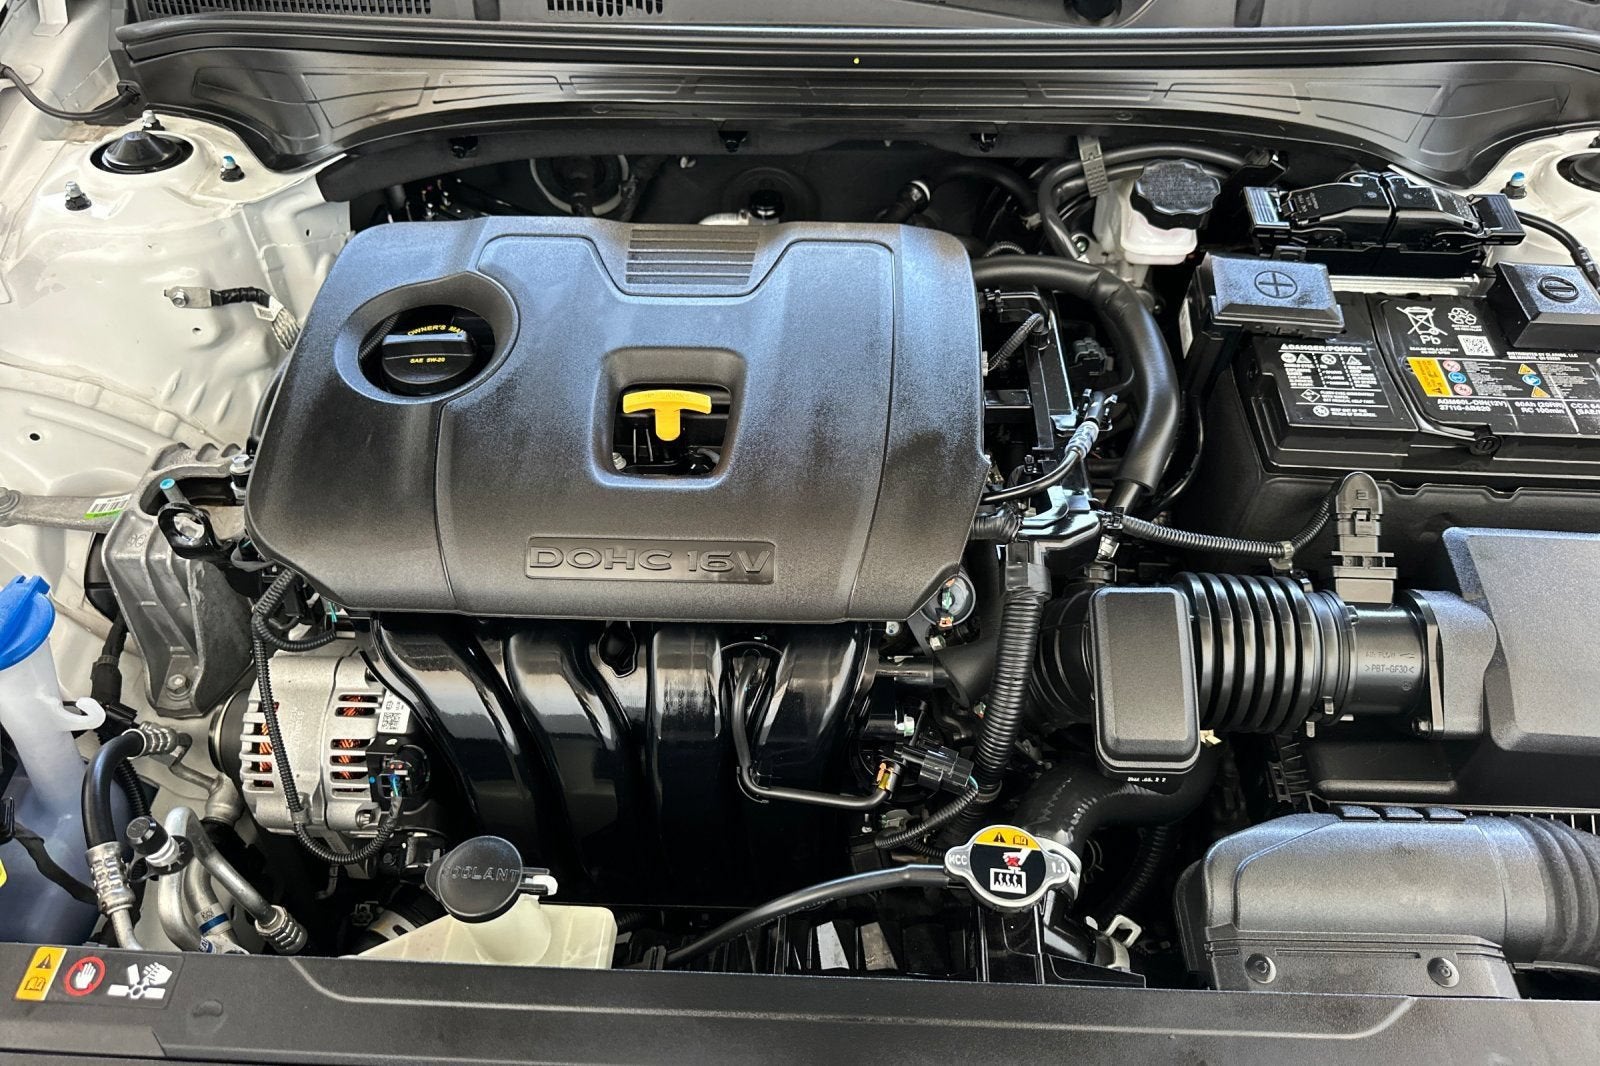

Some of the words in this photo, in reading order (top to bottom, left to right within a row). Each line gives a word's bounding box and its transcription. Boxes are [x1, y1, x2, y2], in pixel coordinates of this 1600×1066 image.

[408, 325, 446, 336] OWNER'S
[1420, 335, 1441, 344] Pb
[529, 546, 673, 571] DOHC
[687, 550, 772, 574] 16V
[442, 865, 520, 882] COOLANT
[1051, 862, 1066, 874] 1.1
